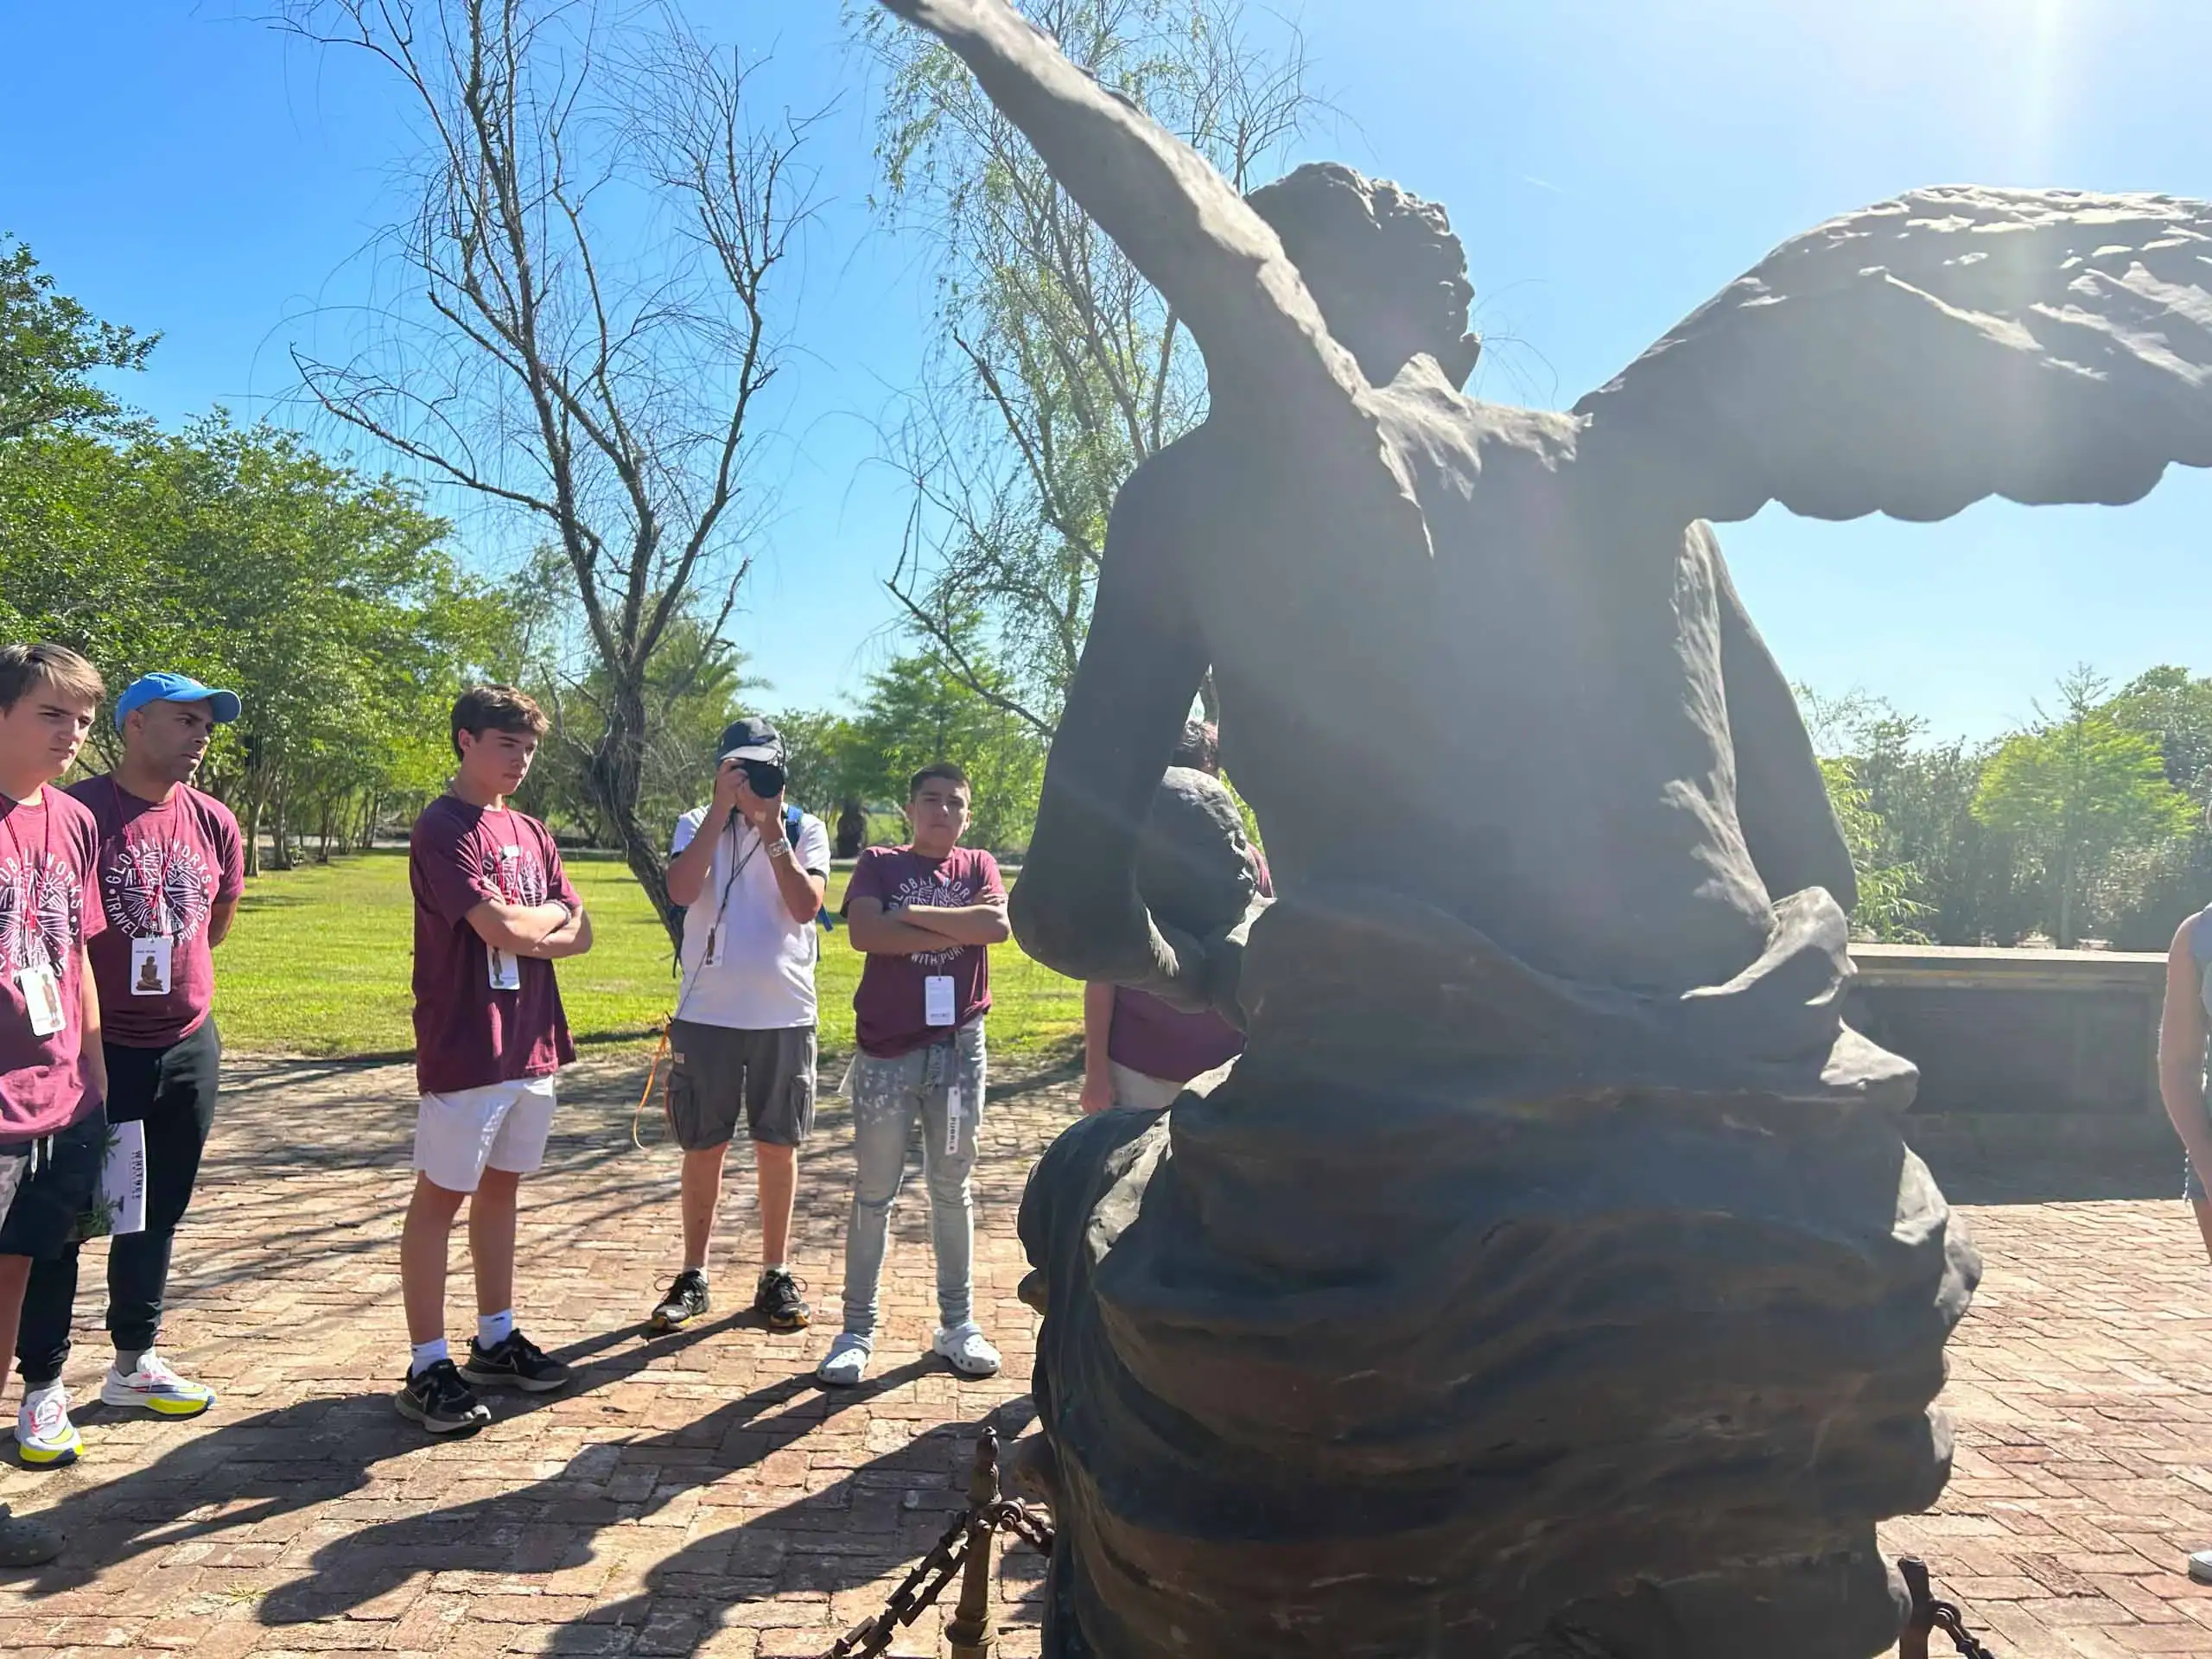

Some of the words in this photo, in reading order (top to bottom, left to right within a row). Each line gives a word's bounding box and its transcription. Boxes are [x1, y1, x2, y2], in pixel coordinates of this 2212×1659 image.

[105, 894, 139, 939] TRAVEL
[177, 895, 211, 946] PURPOSE
[911, 951, 938, 965] WITH
